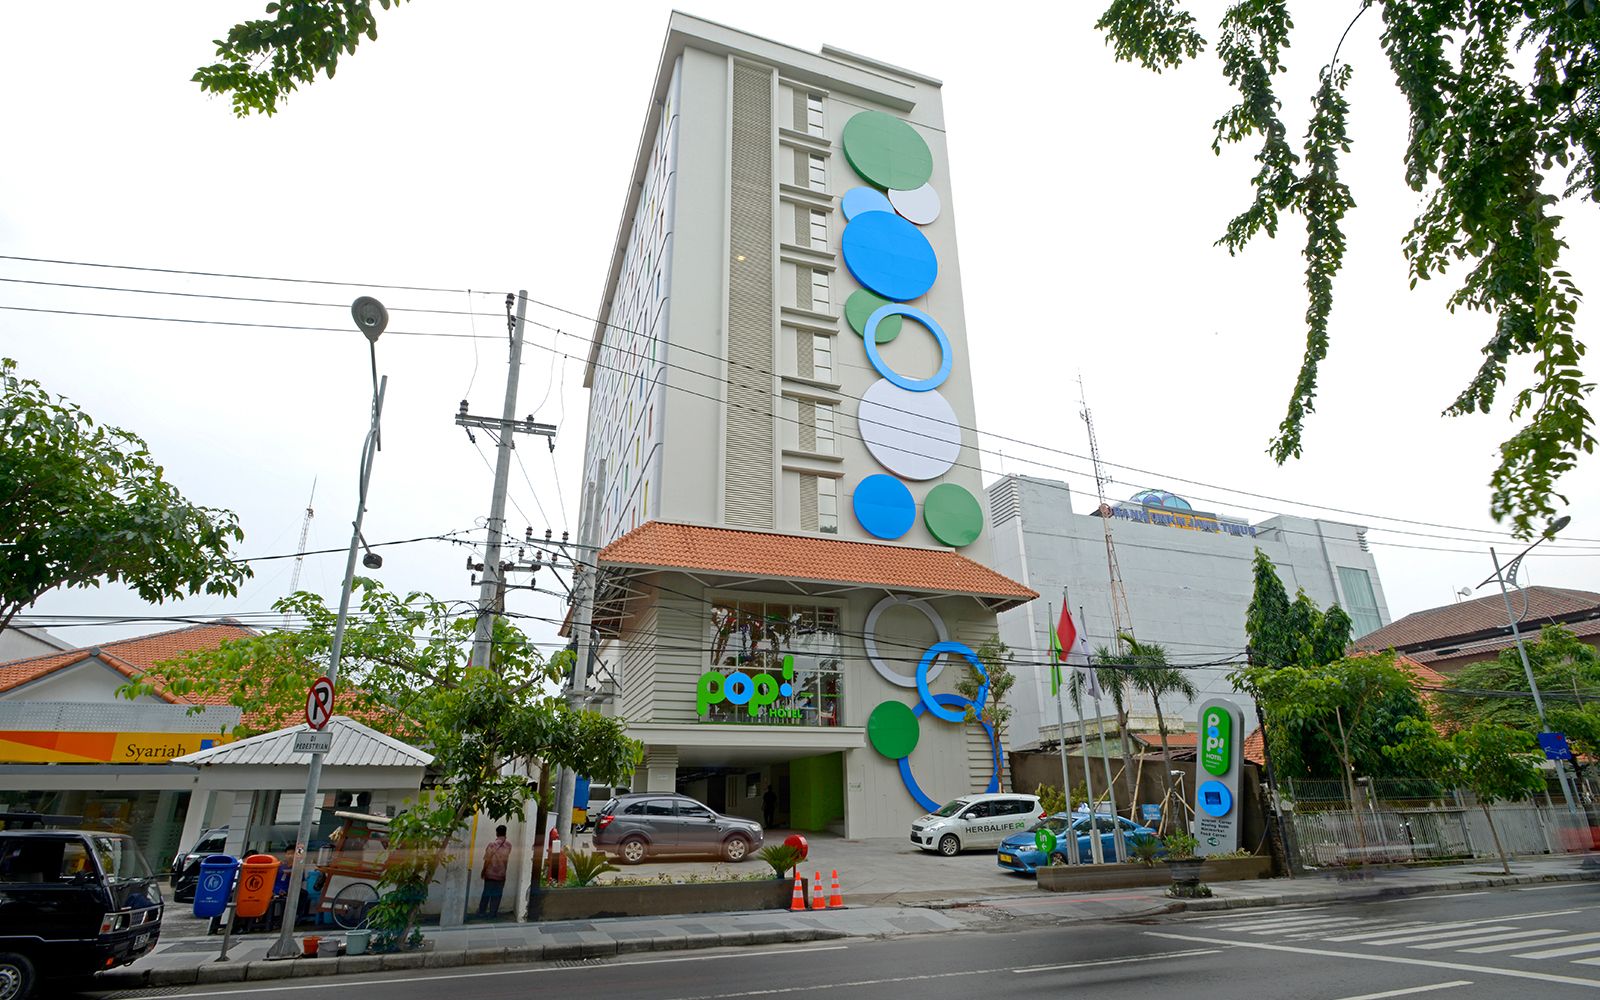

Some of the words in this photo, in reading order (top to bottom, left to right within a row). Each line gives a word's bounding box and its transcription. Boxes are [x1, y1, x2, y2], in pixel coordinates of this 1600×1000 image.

[696, 655, 794, 717] pop!
[313, 687, 329, 720] P
[769, 708, 803, 719] HOTEL
[125, 743, 187, 761] Syariah
[1206, 753, 1222, 761] HOTEL
